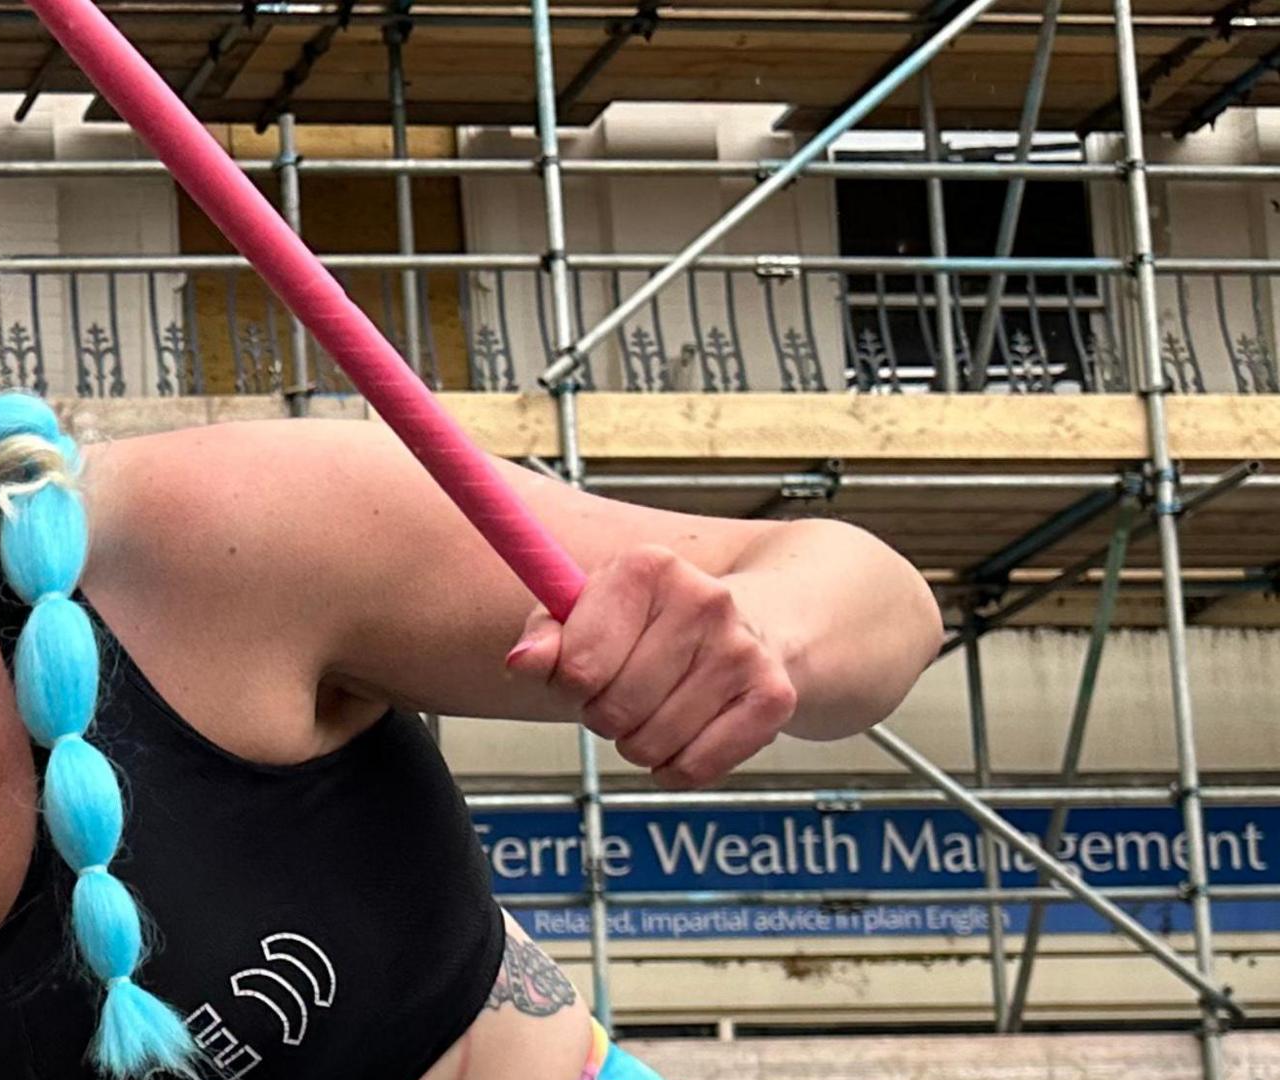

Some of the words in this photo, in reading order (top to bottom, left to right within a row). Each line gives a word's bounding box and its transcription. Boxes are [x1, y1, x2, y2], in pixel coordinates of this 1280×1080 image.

[647, 816, 861, 876] Wealth
[534, 908, 636, 936] Relaed,
[642, 907, 748, 937] impartial
[753, 906, 832, 933] advice
[864, 907, 923, 934] plain
